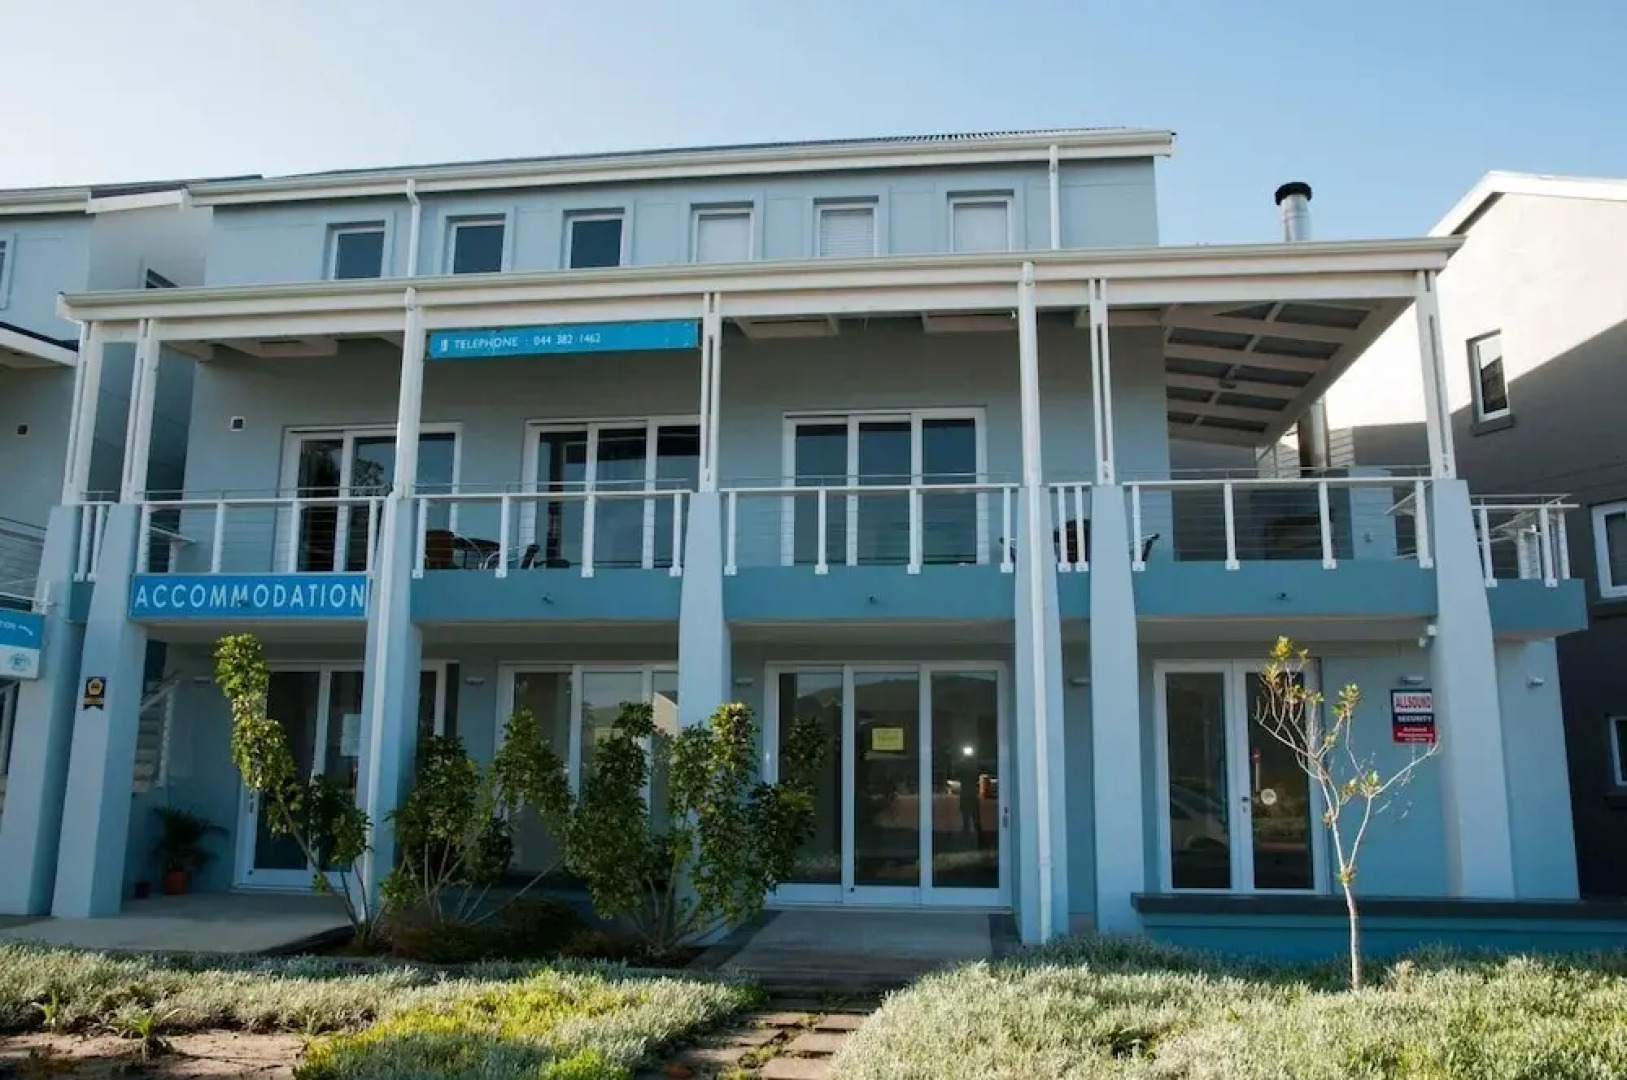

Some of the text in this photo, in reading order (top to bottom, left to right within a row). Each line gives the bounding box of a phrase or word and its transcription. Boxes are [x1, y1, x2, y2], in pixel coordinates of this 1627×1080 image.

[455, 336, 518, 349] TELEPHONE
[533, 335, 551, 346] 044
[557, 334, 573, 345] 382
[580, 333, 601, 344] 1462
[134, 583, 365, 608] ACCOMMODATION
[1397, 715, 1432, 723] SECURITY
